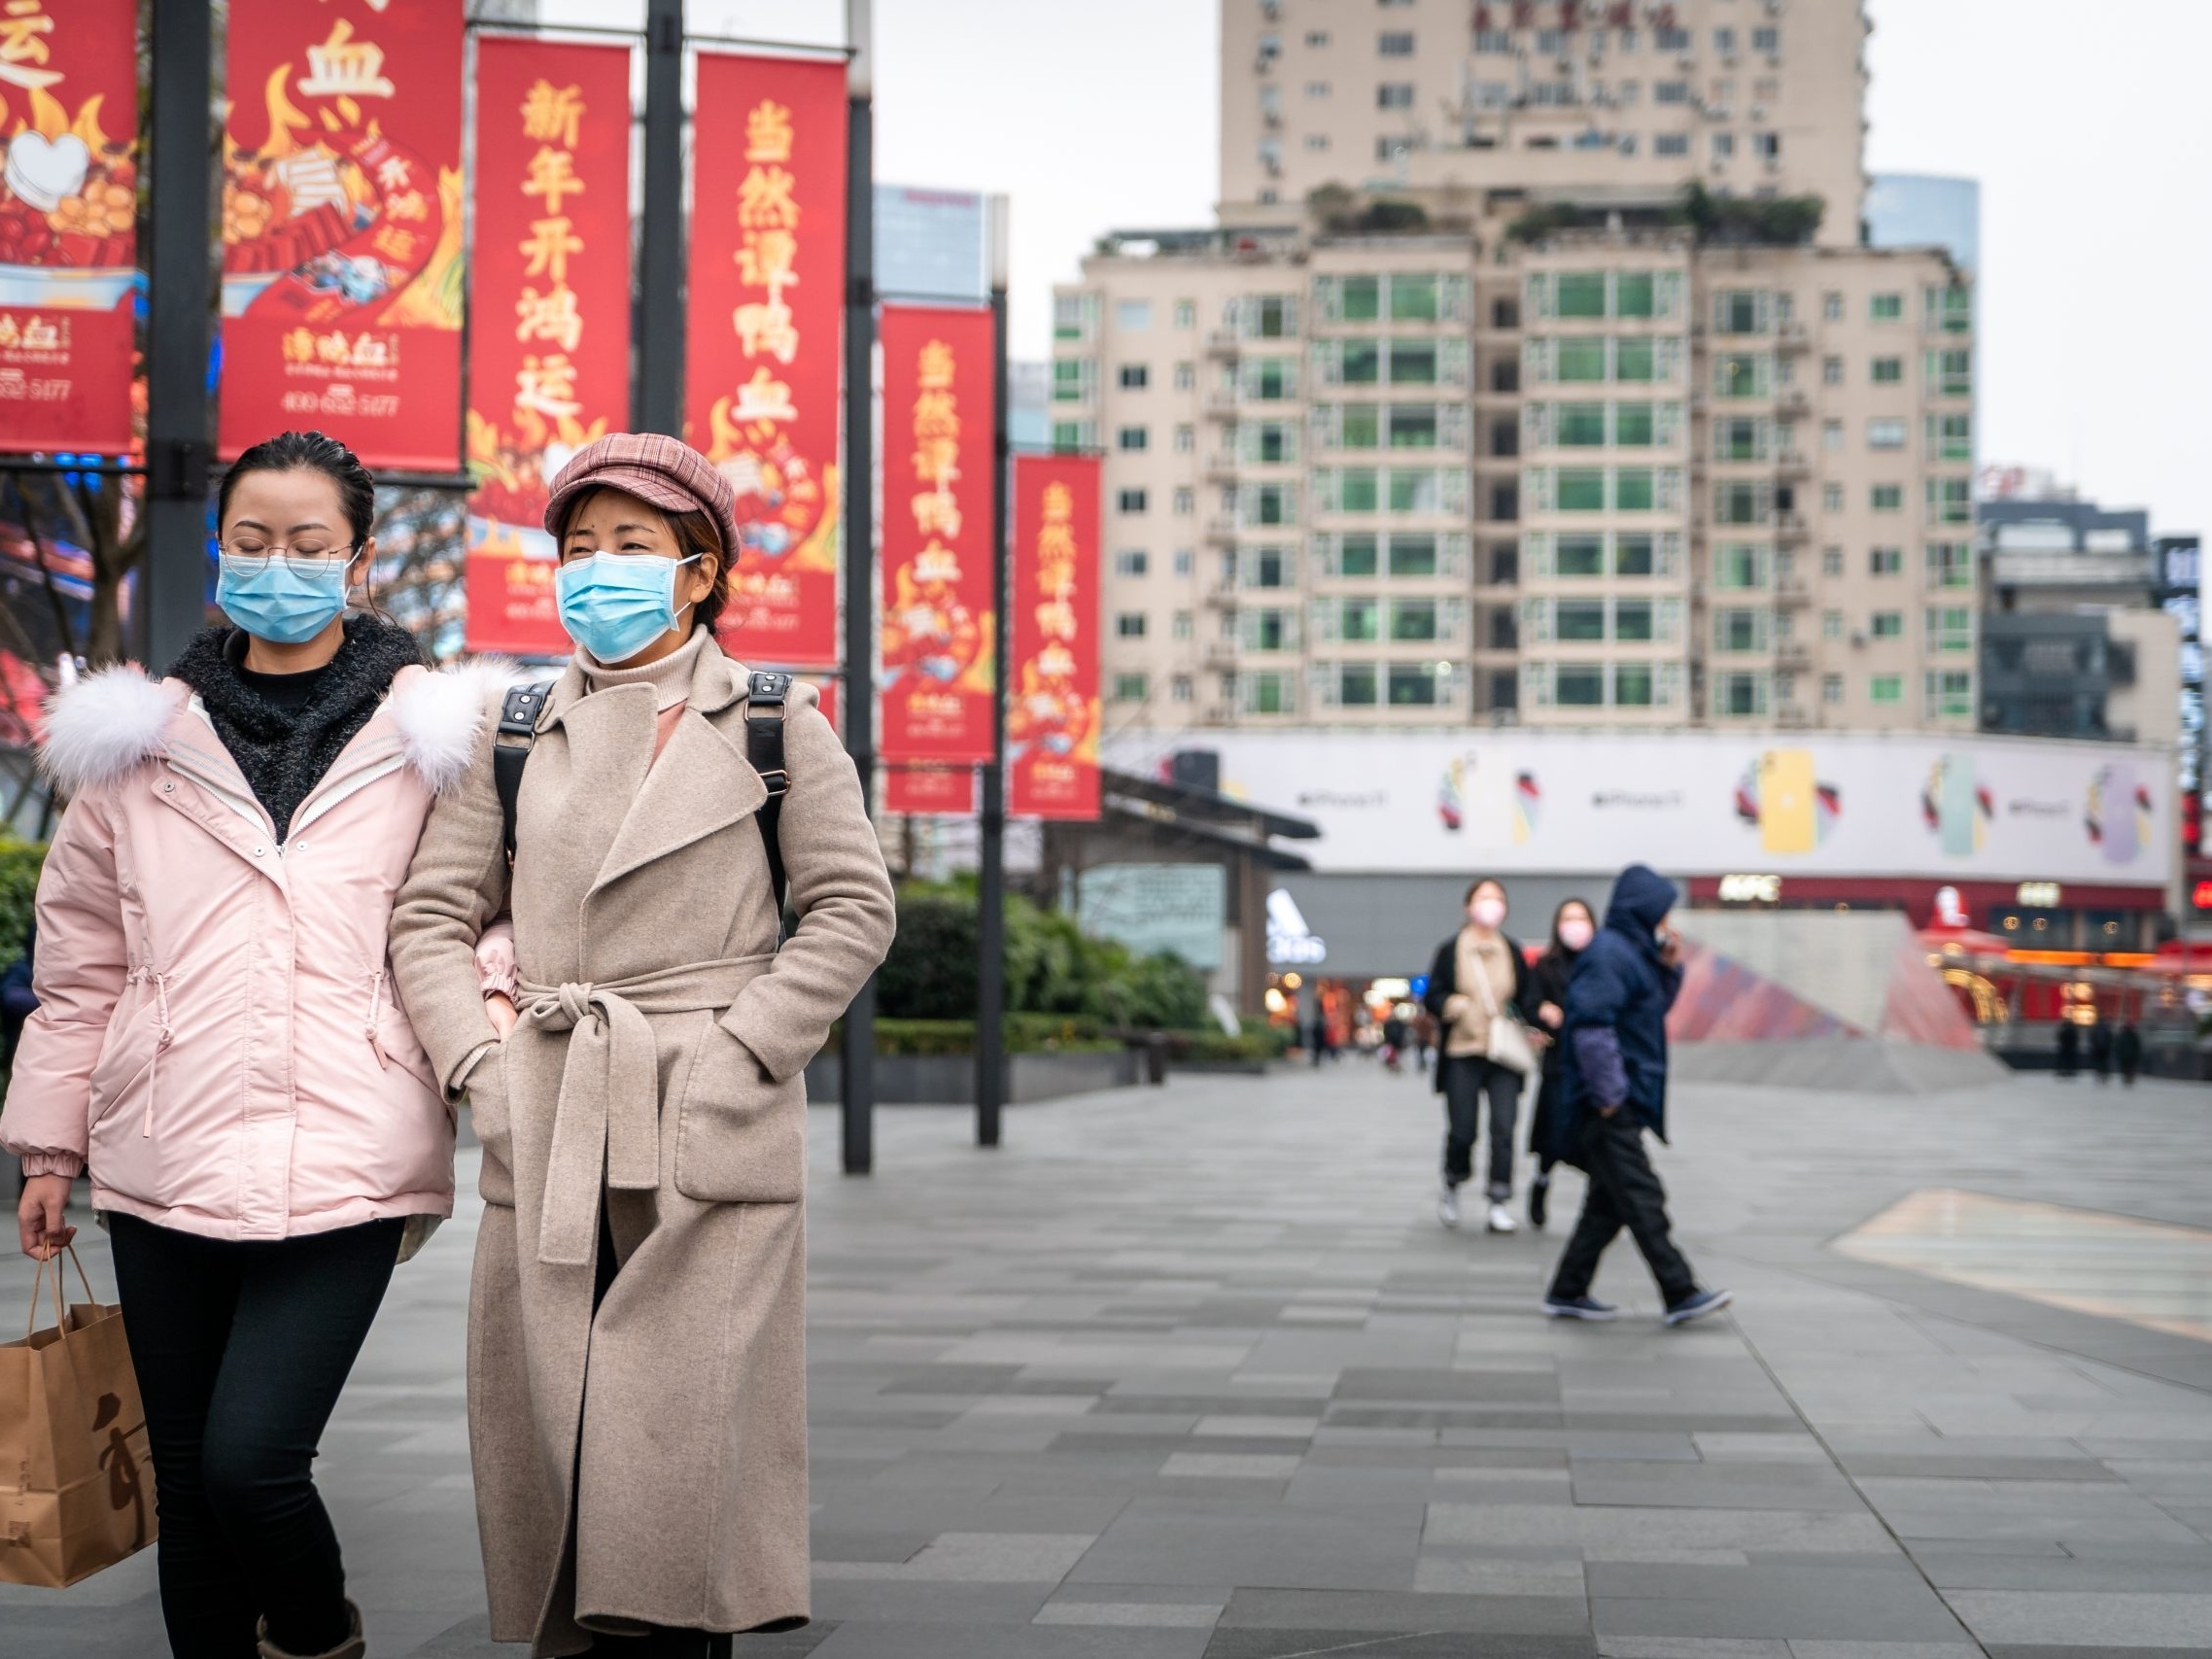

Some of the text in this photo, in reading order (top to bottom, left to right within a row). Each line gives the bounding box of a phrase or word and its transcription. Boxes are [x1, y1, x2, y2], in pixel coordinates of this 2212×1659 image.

[296, 17, 396, 97] 血
[516, 78, 585, 418] 新年开鸿运
[733, 98, 799, 423] 当然谭鸭血
[911, 338, 963, 585] 当然谭鸭血
